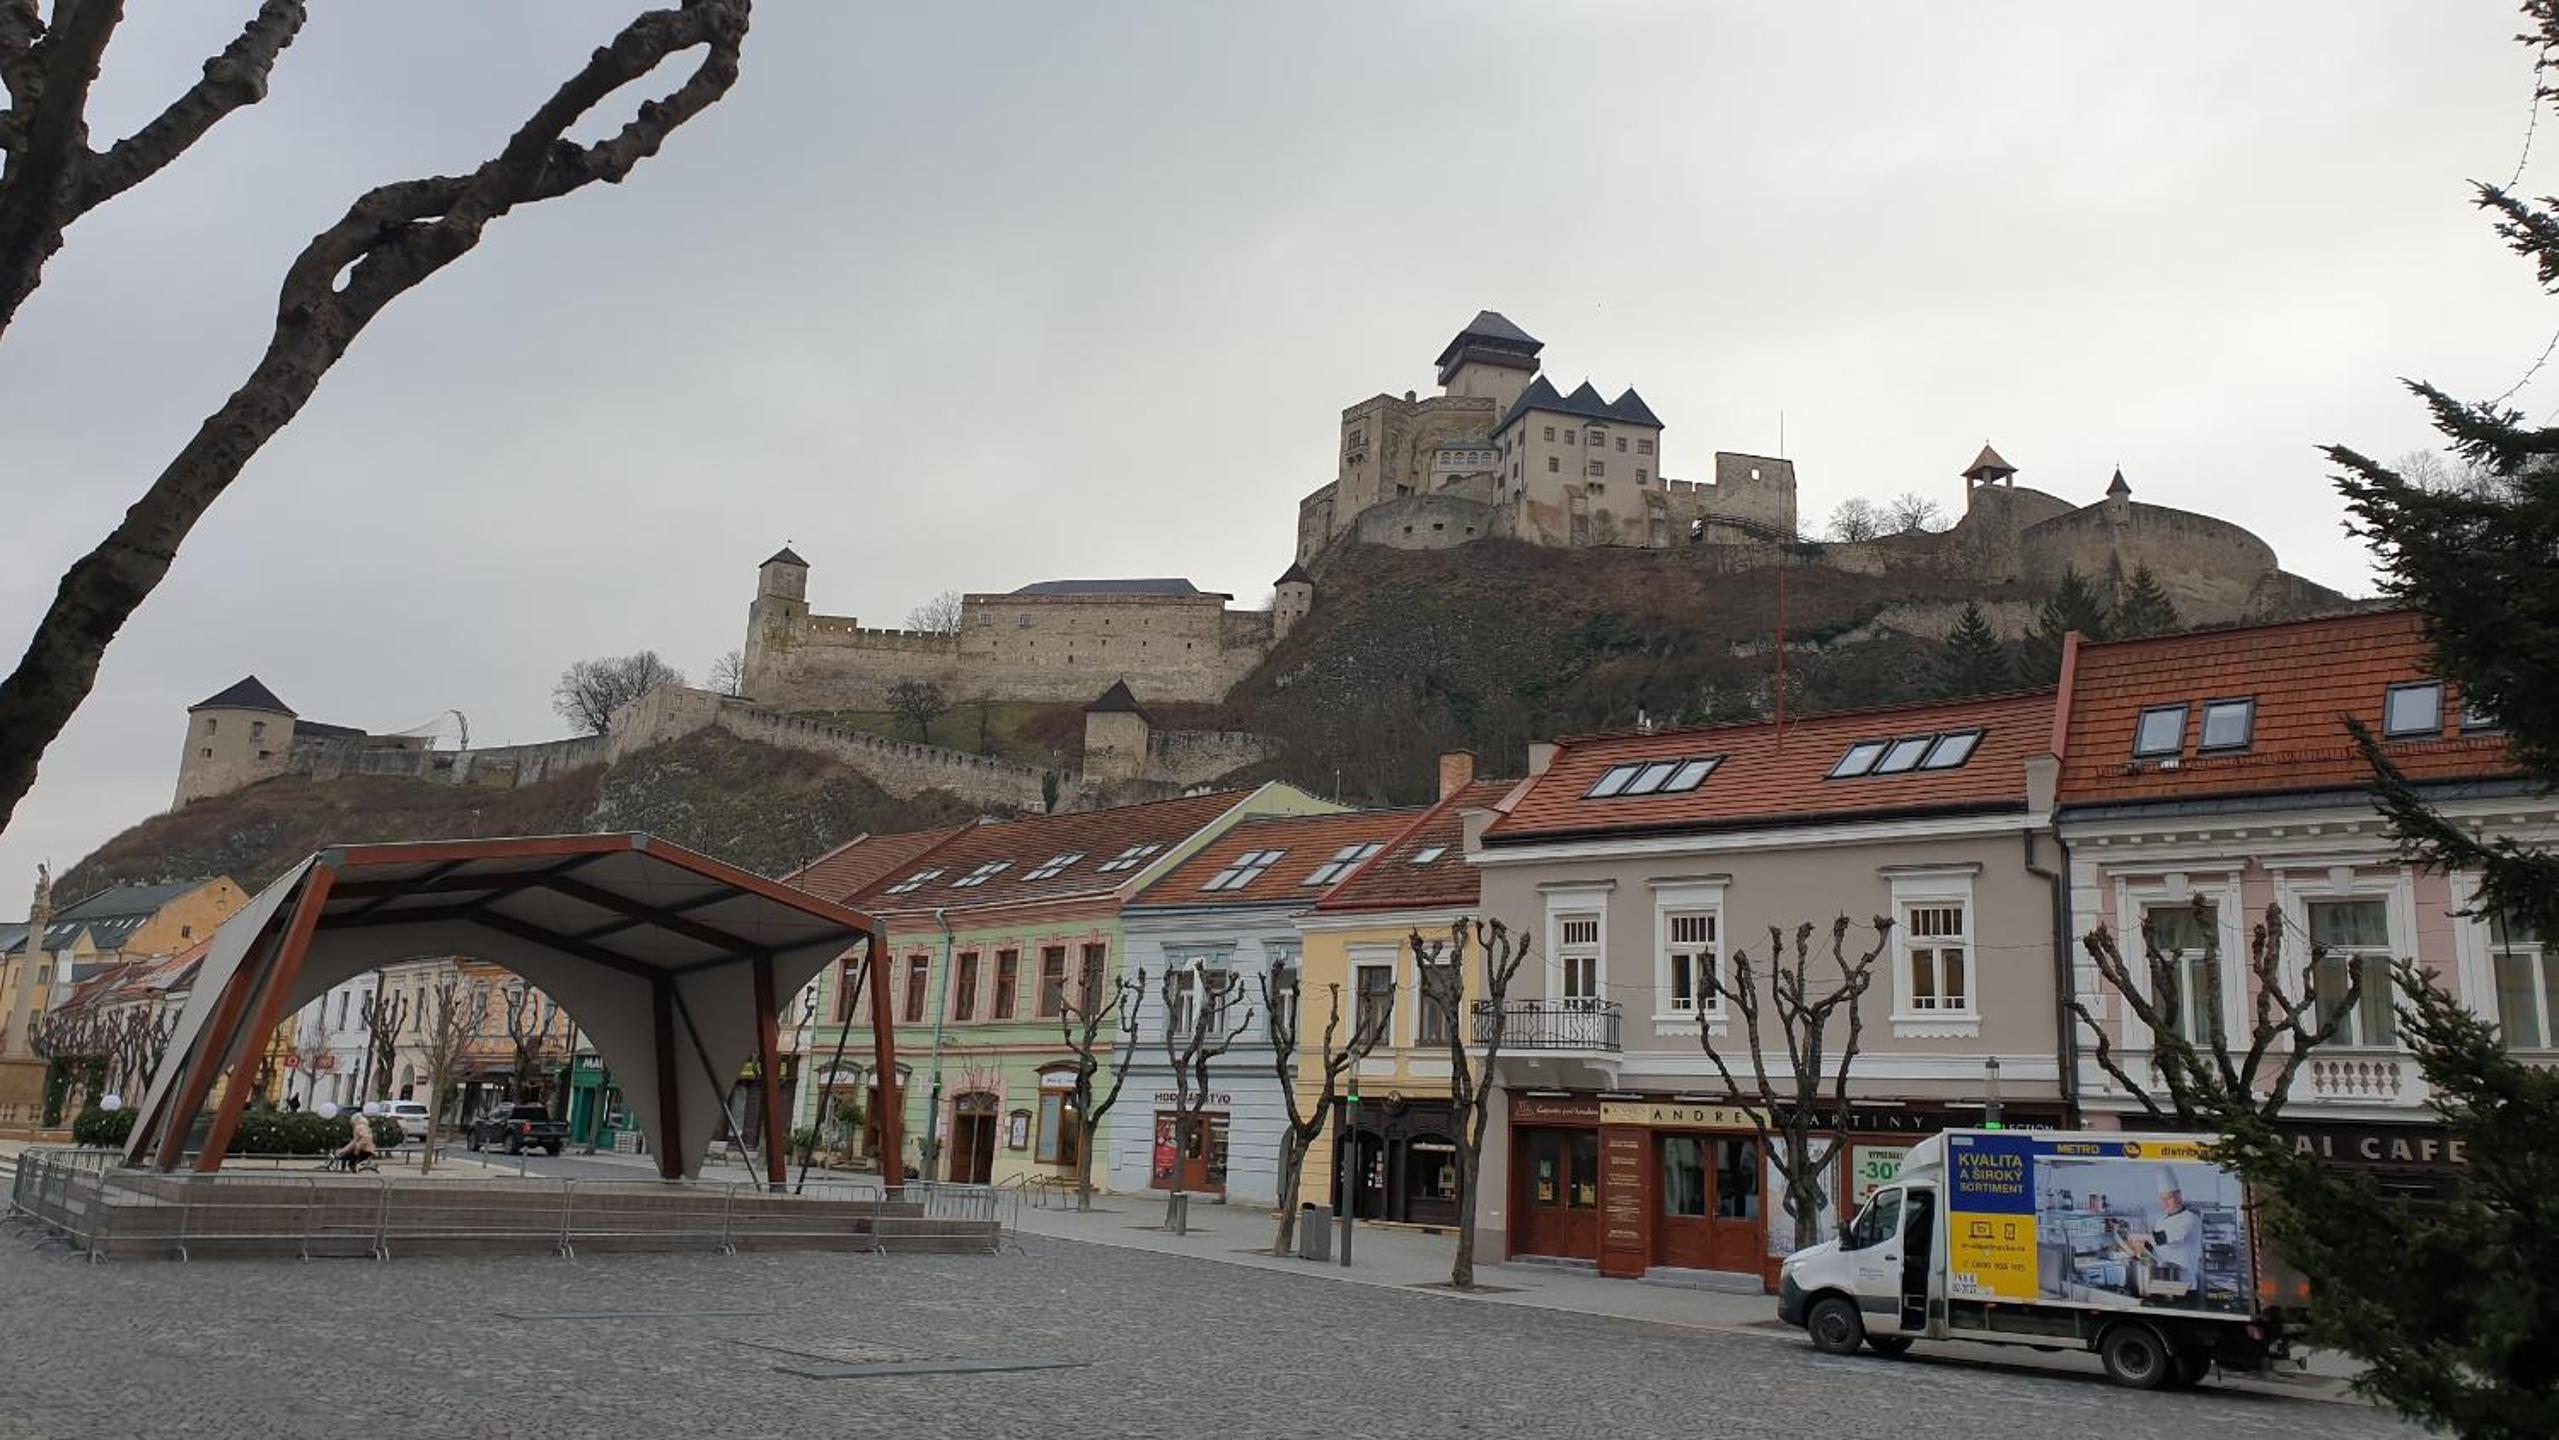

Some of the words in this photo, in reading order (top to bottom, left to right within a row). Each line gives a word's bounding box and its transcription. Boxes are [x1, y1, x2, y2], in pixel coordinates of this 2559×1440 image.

[1154, 1092, 1232, 1104] HODÁTVO
[1653, 1108, 1763, 1124] ANDRE
[1786, 1113, 1924, 1129] ARTINY
[1974, 1122, 2053, 1132] CLECTION
[2056, 1143, 2100, 1155] METRO
[2160, 1146, 2216, 1158] distrib
[1958, 1152, 2023, 1168] KVALITA
[1960, 1169, 1969, 1180] A
[1959, 1182, 2024, 1194] SORTIMENT
